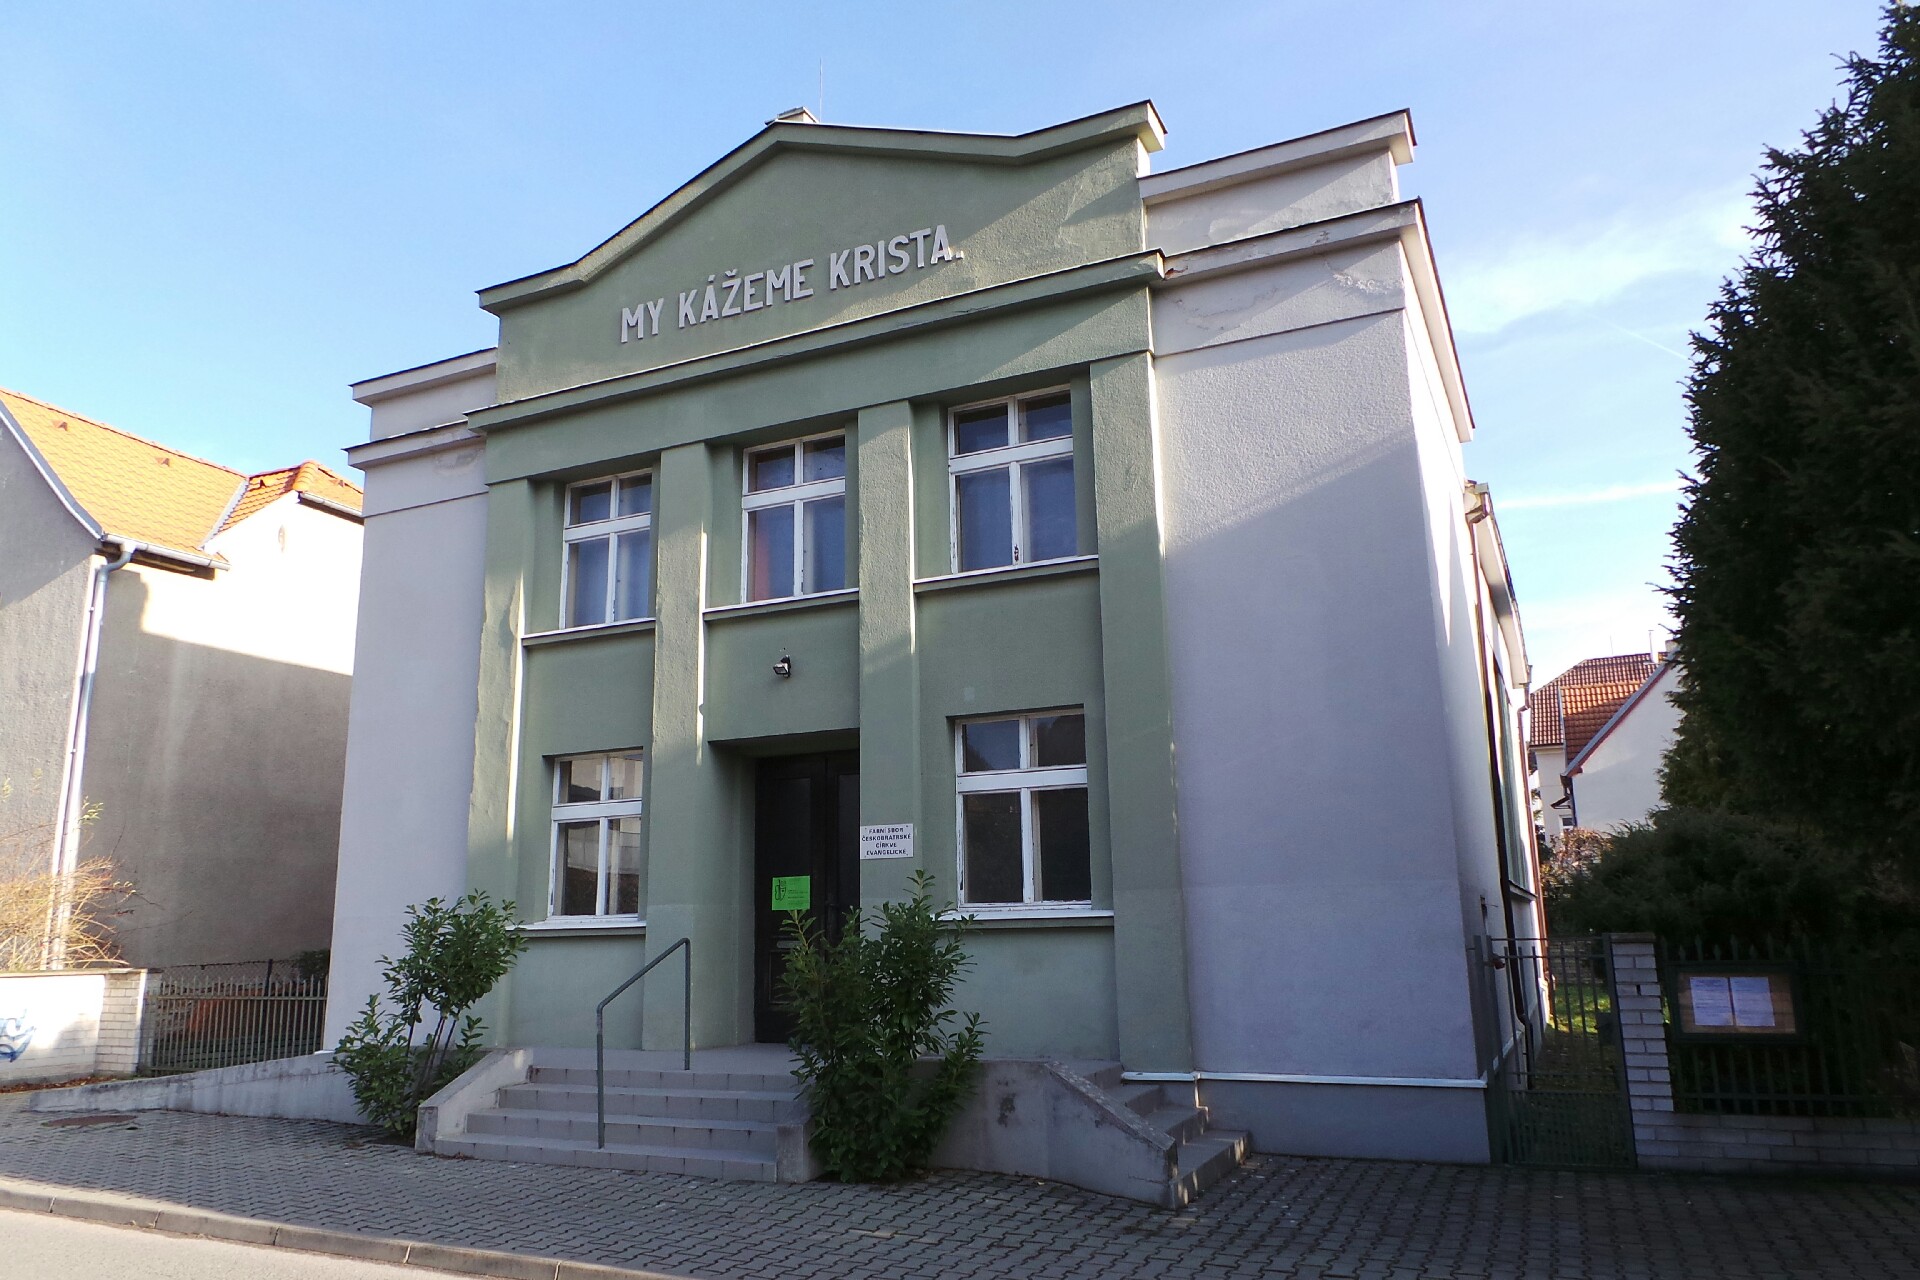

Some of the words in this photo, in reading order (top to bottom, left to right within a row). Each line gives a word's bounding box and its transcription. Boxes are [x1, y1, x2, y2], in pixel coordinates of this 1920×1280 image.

[620, 297, 664, 343] MY
[678, 258, 814, 329] KÁŽEME
[861, 833, 911, 842] ČESKOBRATRSKÉ
[866, 848, 906, 856] EVANGELICKÉ
